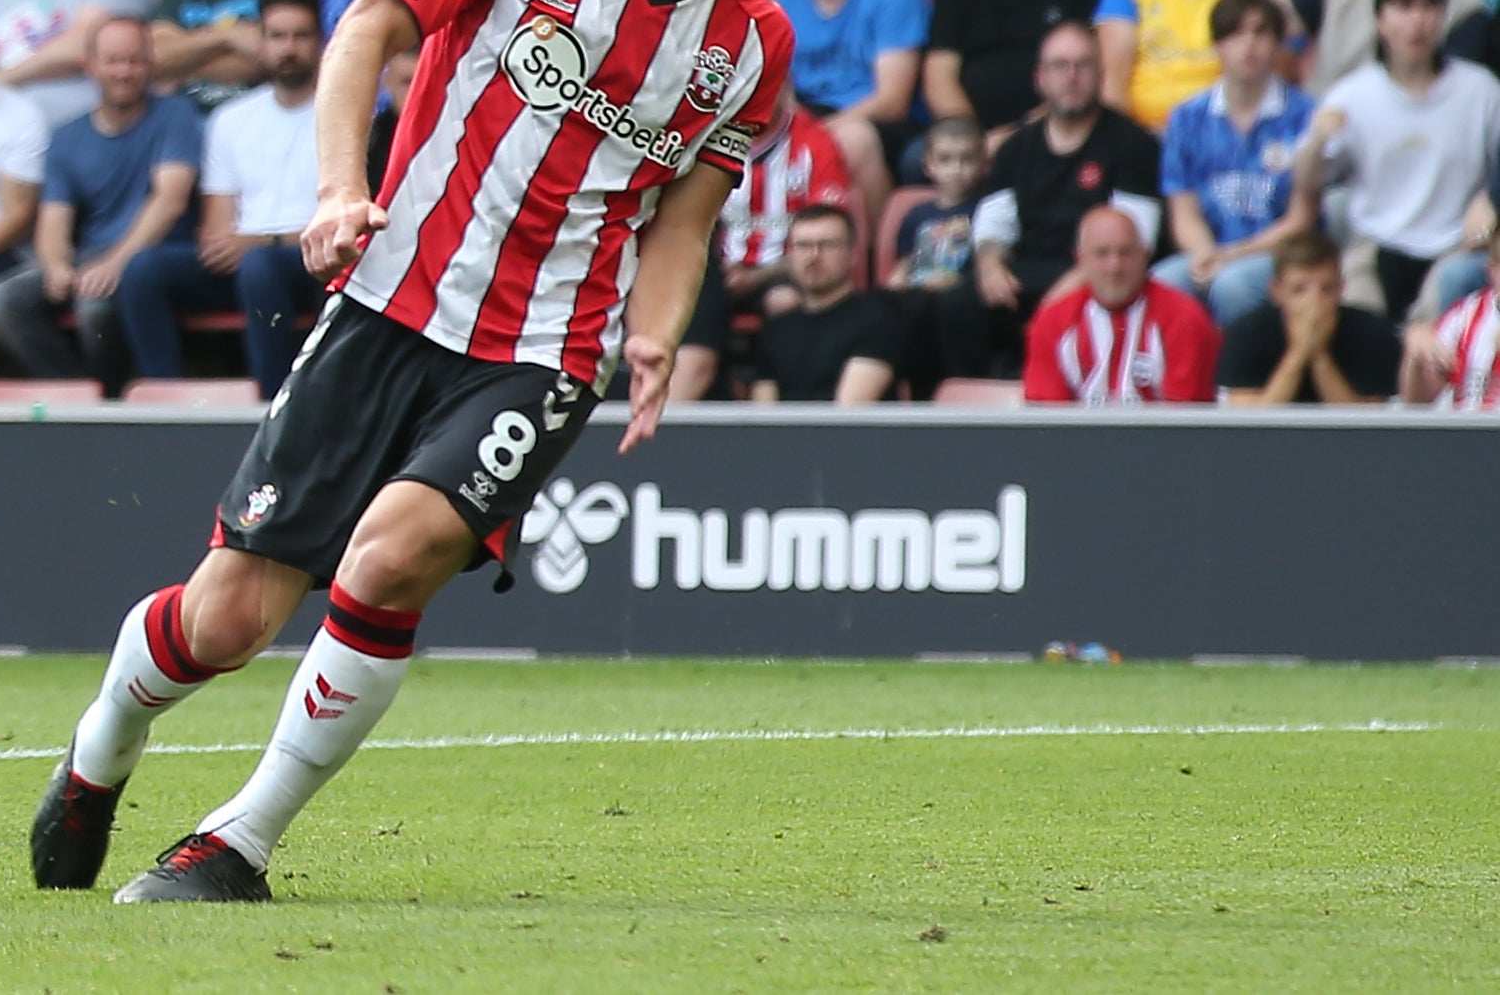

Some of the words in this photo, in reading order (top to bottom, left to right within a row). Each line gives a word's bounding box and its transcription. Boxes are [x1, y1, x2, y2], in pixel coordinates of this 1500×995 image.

[523, 44, 686, 165] Sportsbet.io
[478, 410, 537, 481] 8
[631, 481, 1027, 594] hummel
